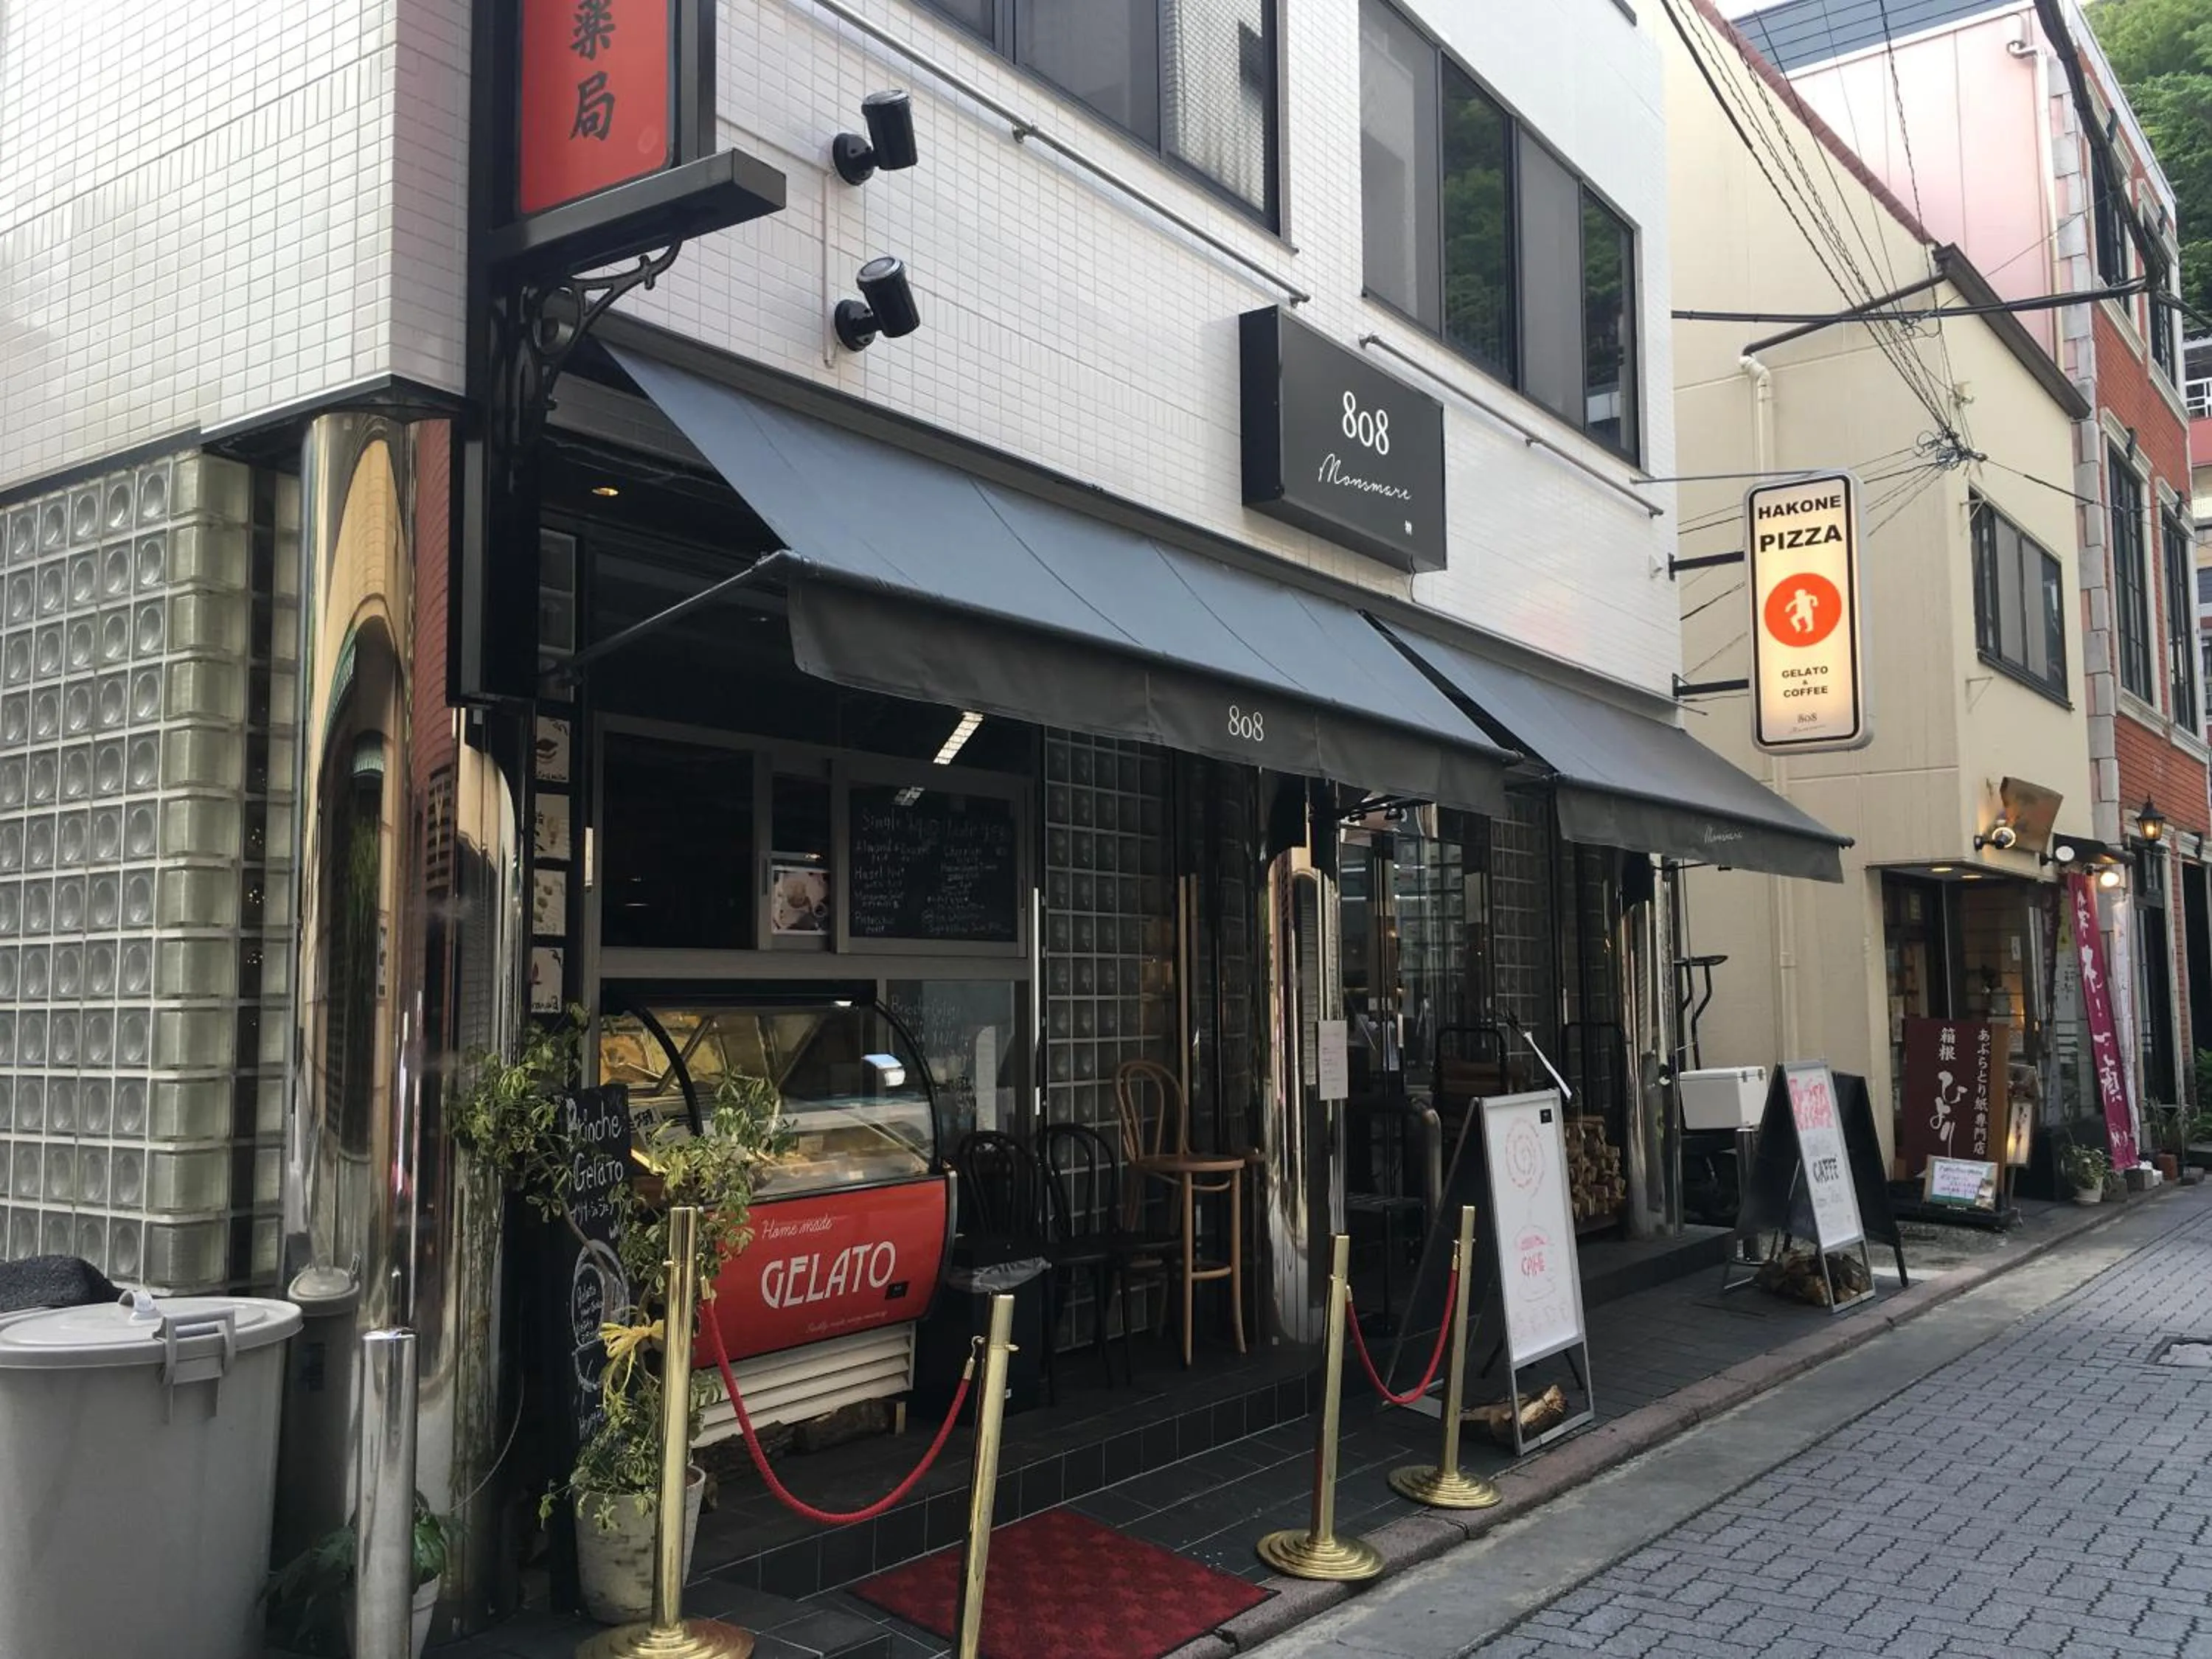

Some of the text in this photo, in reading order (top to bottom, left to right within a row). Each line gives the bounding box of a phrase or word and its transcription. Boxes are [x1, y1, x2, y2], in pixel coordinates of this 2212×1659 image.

[1342, 390, 1390, 455] 808
[1758, 495, 1842, 520] HAKONE
[1759, 524, 1843, 553] PIZZA
[1781, 665, 1829, 679] GELATO
[1783, 685, 1829, 698] COFFEE
[1228, 704, 1265, 741] 808
[1938, 1027, 1957, 1061] 箱根
[1929, 1070, 1968, 1157] ひより
[761, 1214, 835, 1240] Home made
[761, 1240, 897, 1310] GELATO
